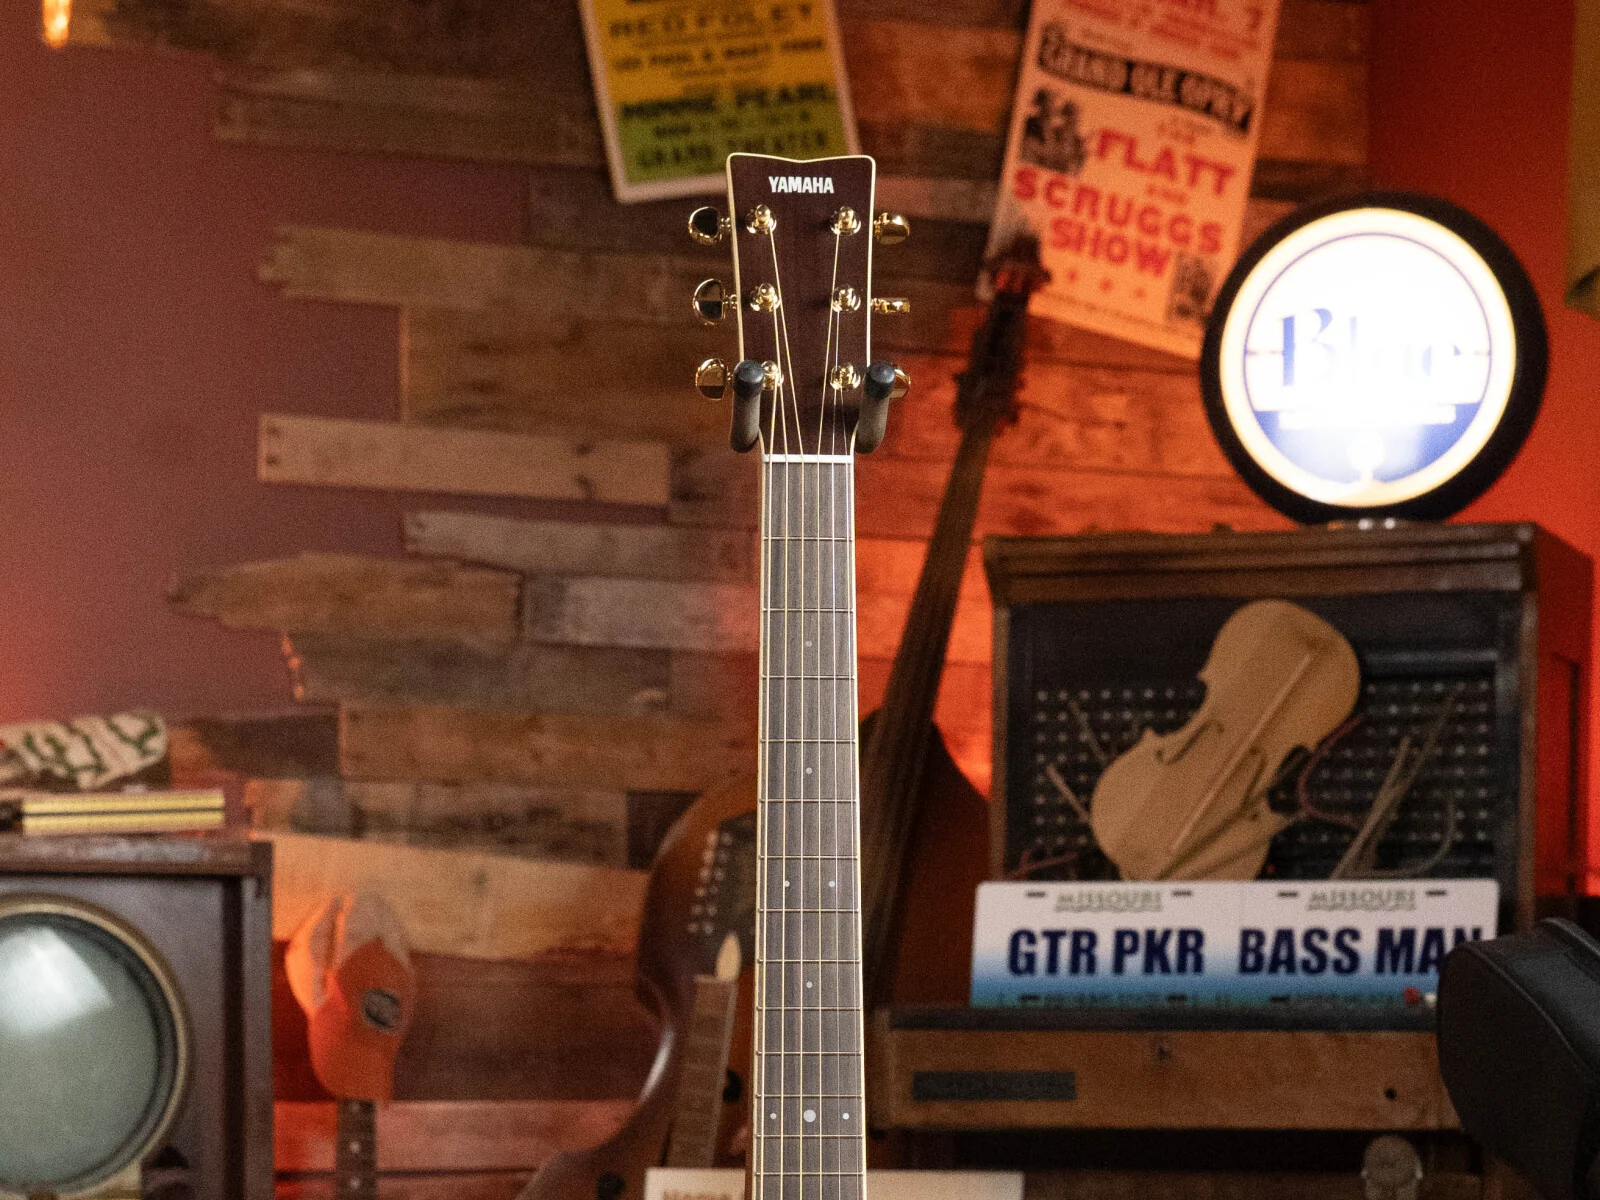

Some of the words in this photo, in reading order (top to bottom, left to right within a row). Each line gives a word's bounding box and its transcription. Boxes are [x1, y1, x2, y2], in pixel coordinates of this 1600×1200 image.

[768, 176, 834, 193] YAMAHA
[1096, 128, 1235, 197] FLATT
[1014, 166, 1223, 255] SCRUGGS
[1050, 217, 1170, 277] SHOW
[1055, 888, 1163, 912] MISSOURI
[1307, 887, 1418, 911] MISSOURI
[1008, 928, 1097, 976] GTR
[1112, 928, 1206, 976] PKR
[1237, 926, 1360, 976] BASS
